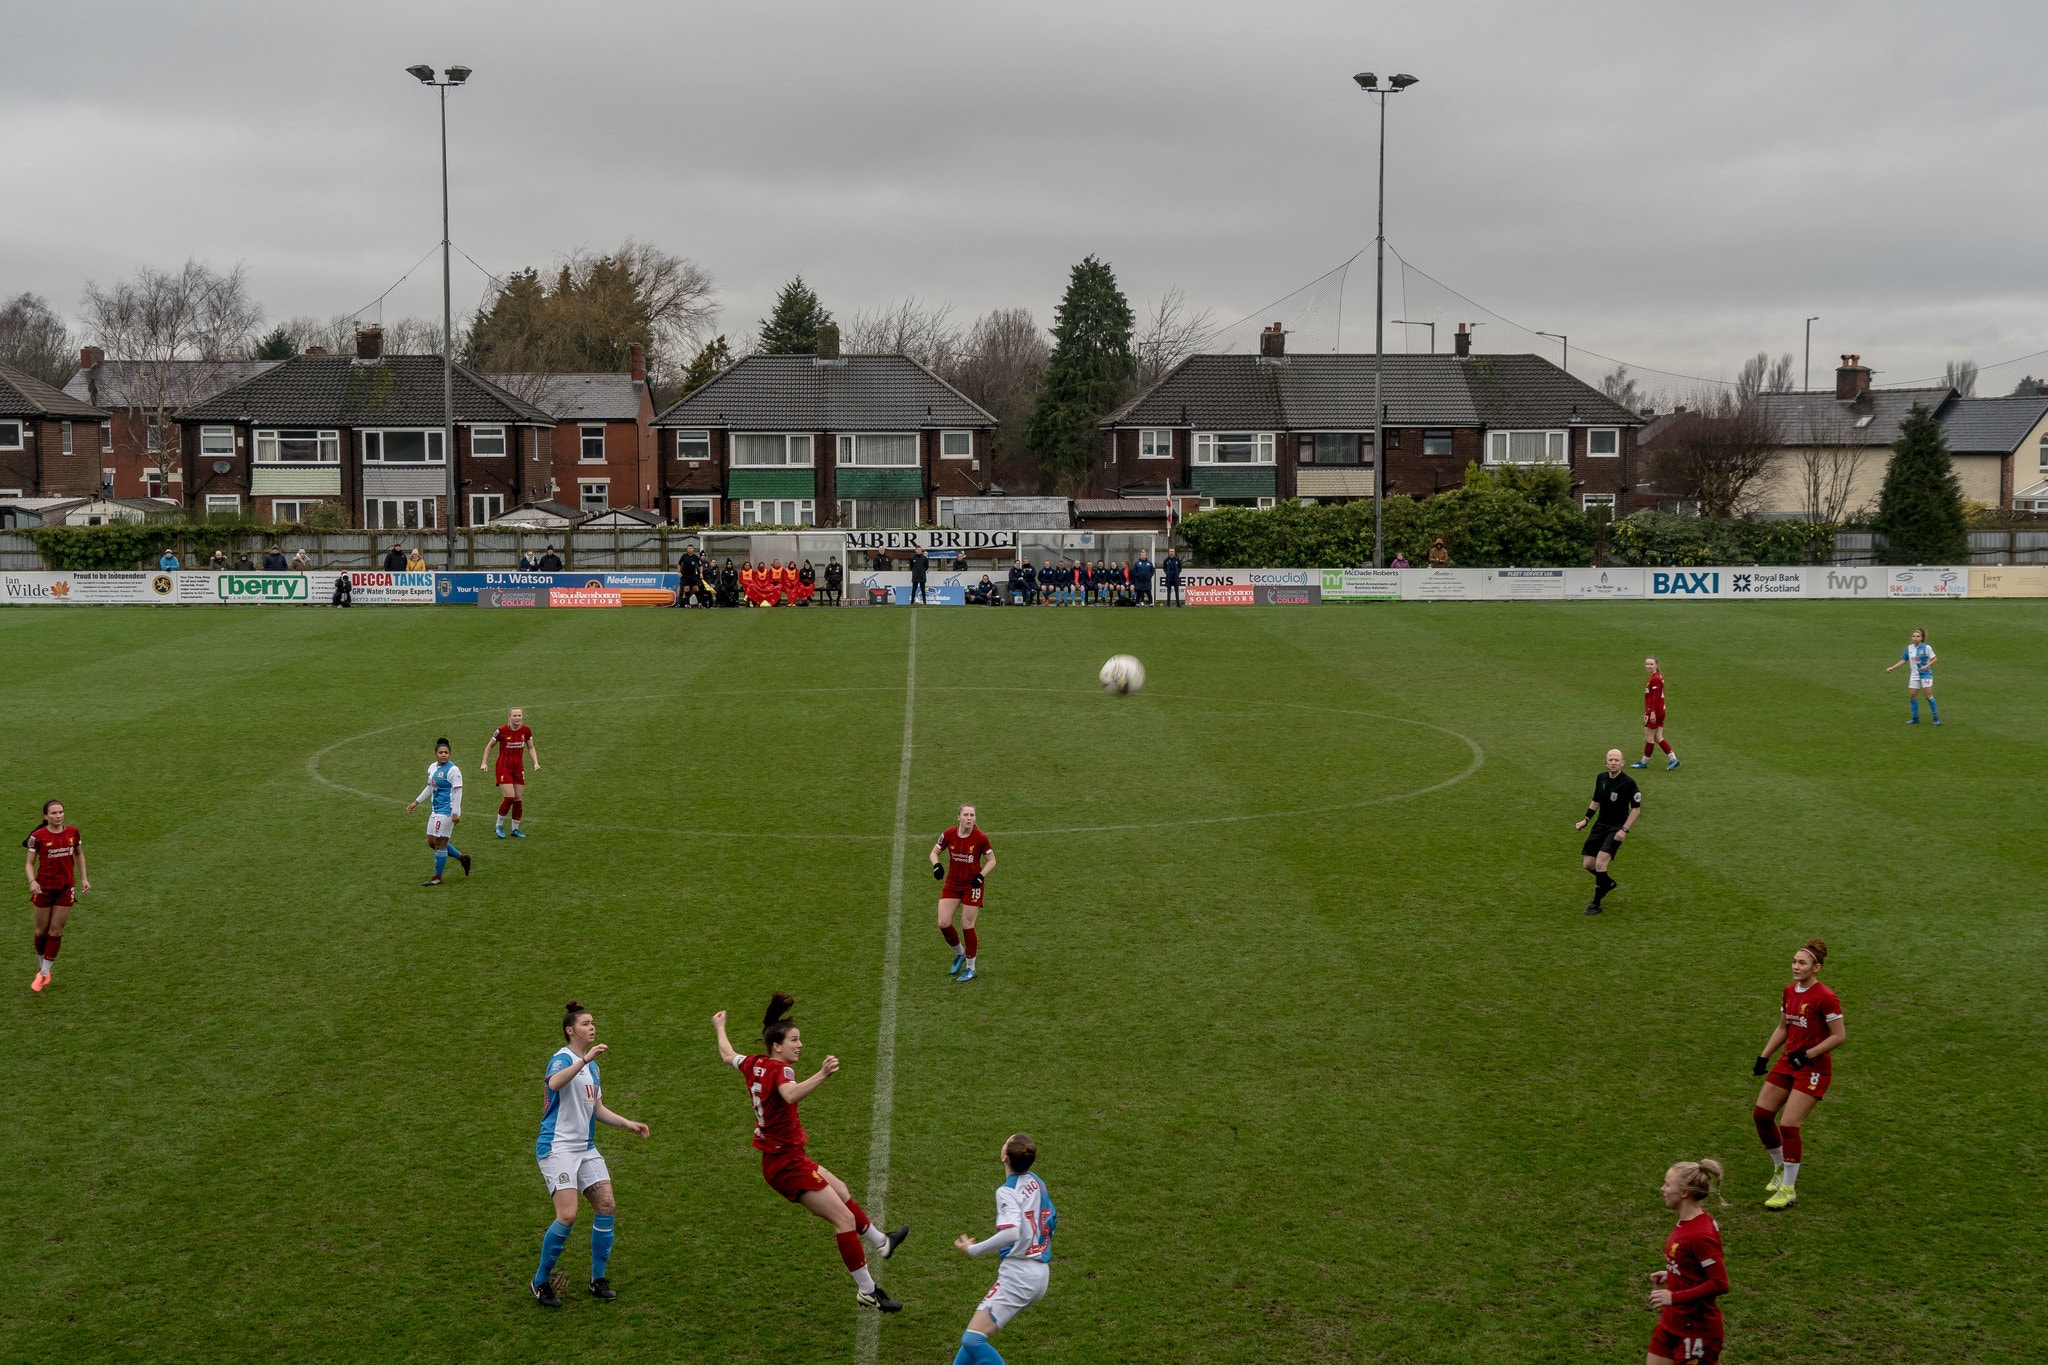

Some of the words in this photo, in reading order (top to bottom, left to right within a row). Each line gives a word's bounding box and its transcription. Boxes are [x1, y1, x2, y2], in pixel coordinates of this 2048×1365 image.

[486, 574, 506, 584] B.J.
[509, 574, 553, 584] Watson
[1160, 577, 1234, 586] EERTONS
[1249, 572, 1300, 582] tecaudio
[1754, 574, 1777, 583] Royal
[1827, 571, 1868, 594] fwp
[228, 575, 298, 599] berry
[1653, 573, 1719, 594] BAXI
[6, 584, 49, 596] Wilde
[386, 588, 407, 596] Storage
[410, 588, 432, 596] Experts
[436, 821, 441, 830] 9
[972, 888, 981, 899] 19
[1810, 1072, 1820, 1085] 8
[1683, 1338, 1704, 1359] 14
